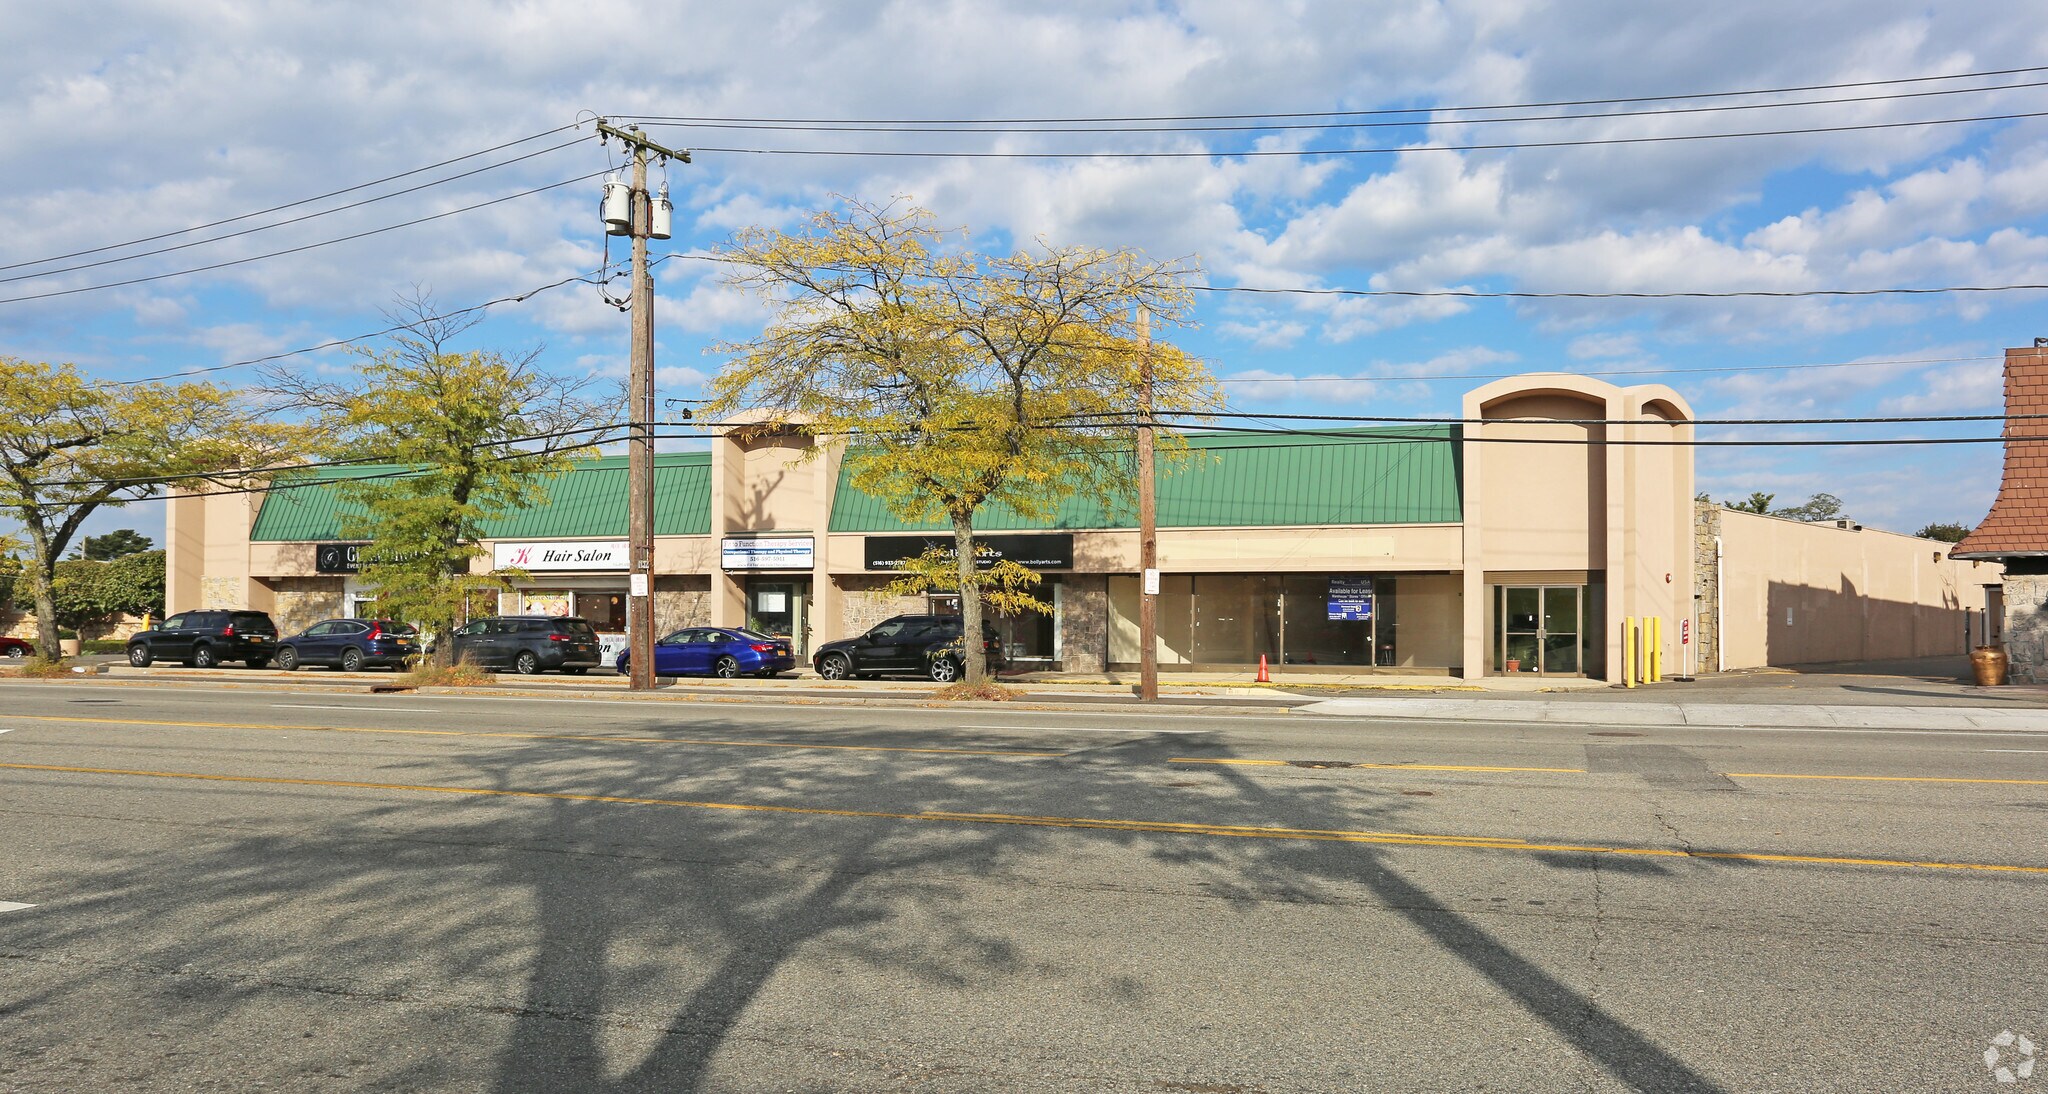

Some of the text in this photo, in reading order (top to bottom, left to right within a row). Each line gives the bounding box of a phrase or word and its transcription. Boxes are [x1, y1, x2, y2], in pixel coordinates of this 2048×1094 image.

[510, 544, 534, 565] K
[542, 548, 612, 563] Hair Salon
[1016, 558, 1062, 567] www.bollyarts.com
